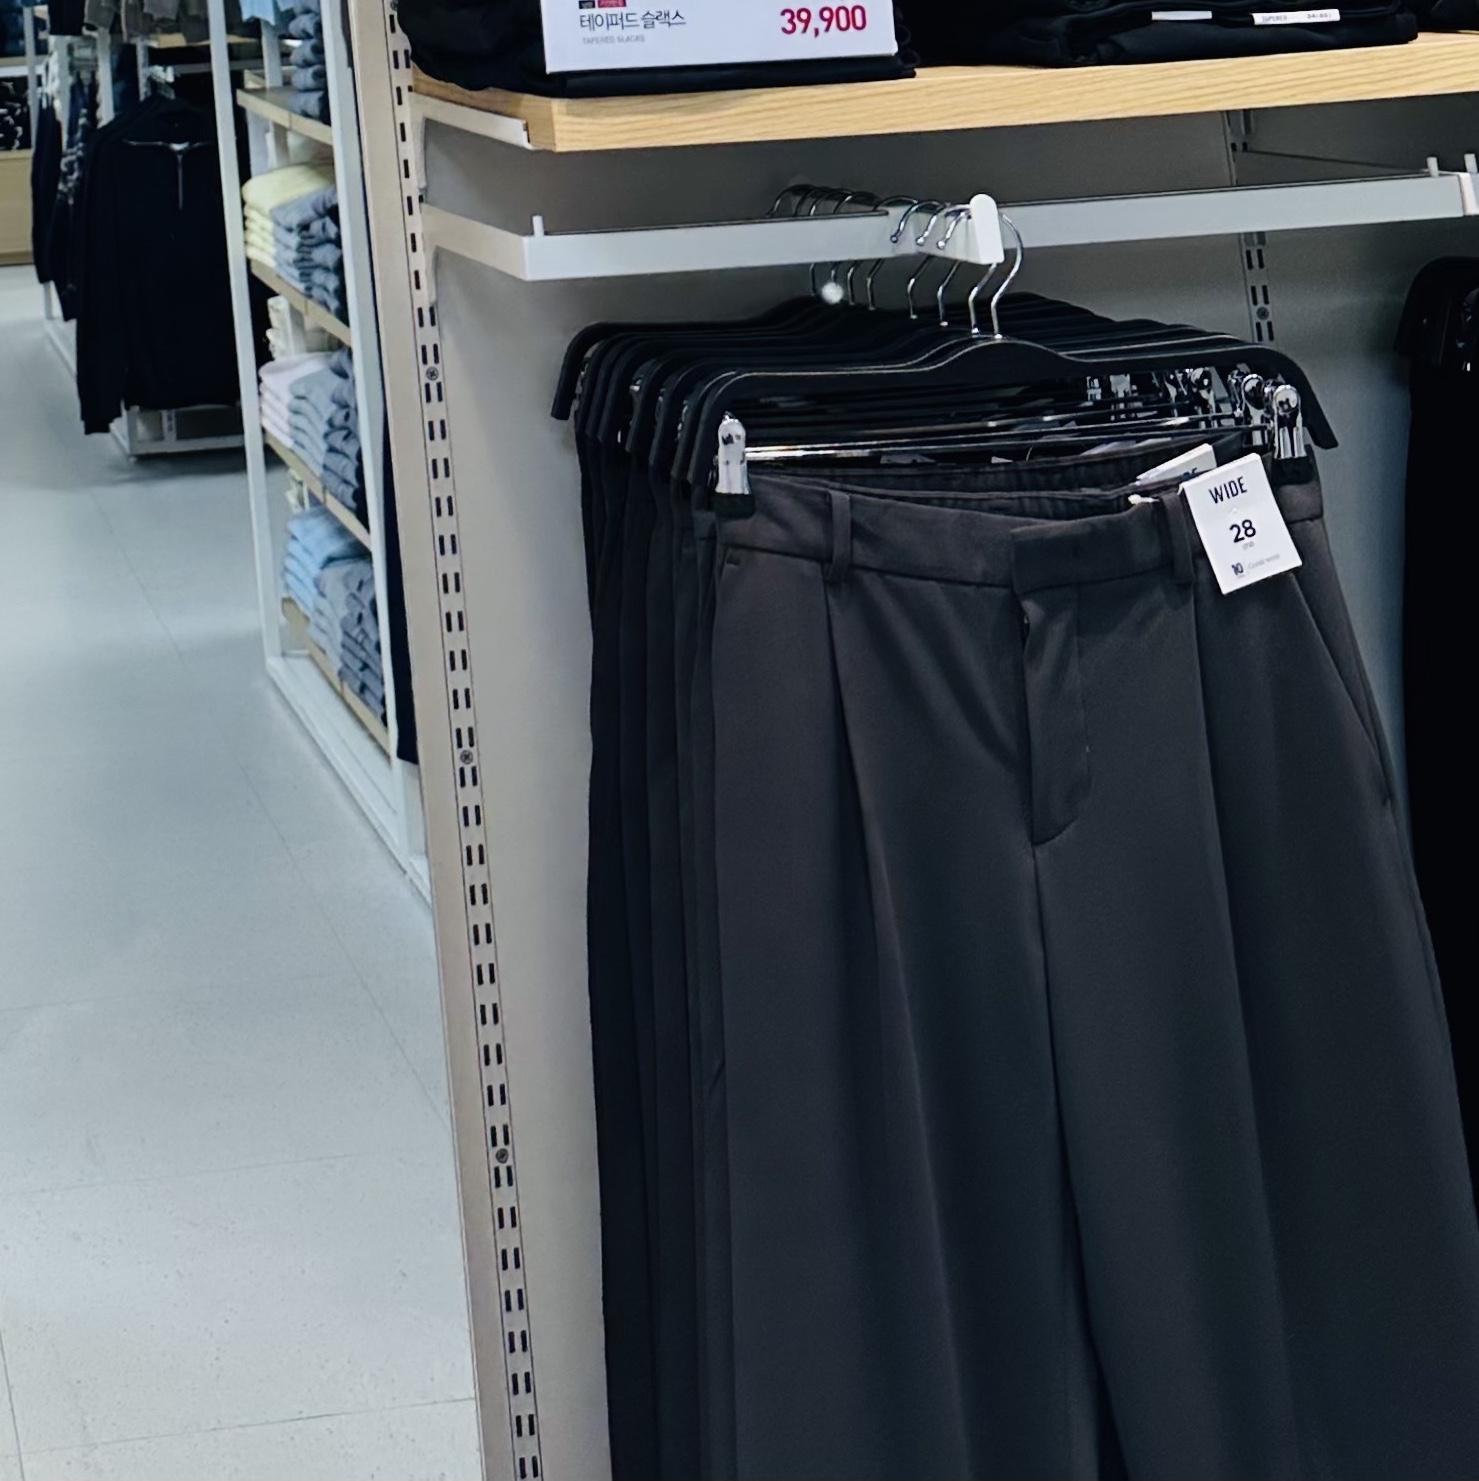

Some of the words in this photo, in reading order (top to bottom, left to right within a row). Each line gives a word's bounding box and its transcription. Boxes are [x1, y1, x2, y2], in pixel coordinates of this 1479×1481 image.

[580, 12, 640, 31] 테이퍼드
[641, 10, 686, 29] 슬랙스
[780, 5, 867, 38] 39,900
[1208, 476, 1247, 504] WIDE
[1229, 519, 1256, 544] 28
